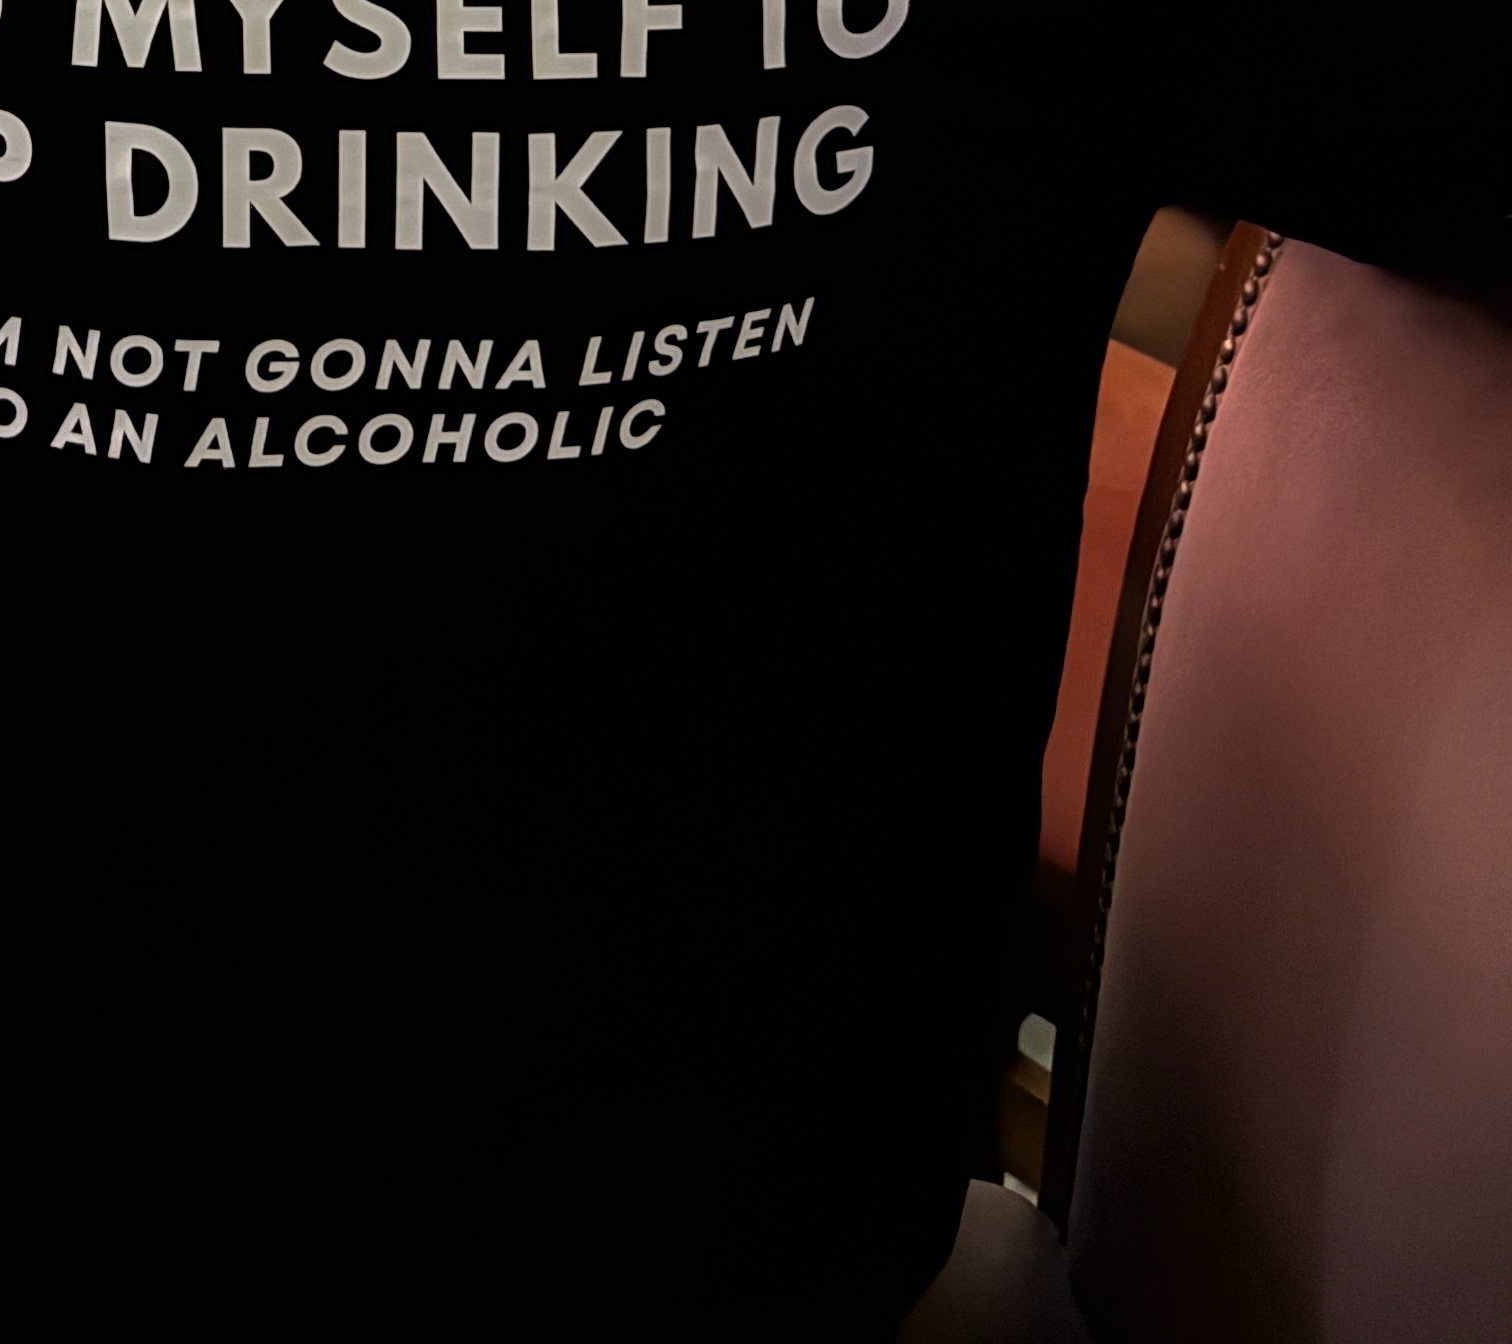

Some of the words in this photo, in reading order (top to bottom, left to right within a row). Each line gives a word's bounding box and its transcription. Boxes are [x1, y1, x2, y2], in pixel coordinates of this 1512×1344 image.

[104, 104, 874, 252] DRINKING
[51, 324, 221, 392] NOT
[244, 338, 547, 394] GONNA
[578, 296, 815, 387] LISTEN
[49, 402, 159, 464] AN
[183, 398, 666, 469] ALCOHOLIC
